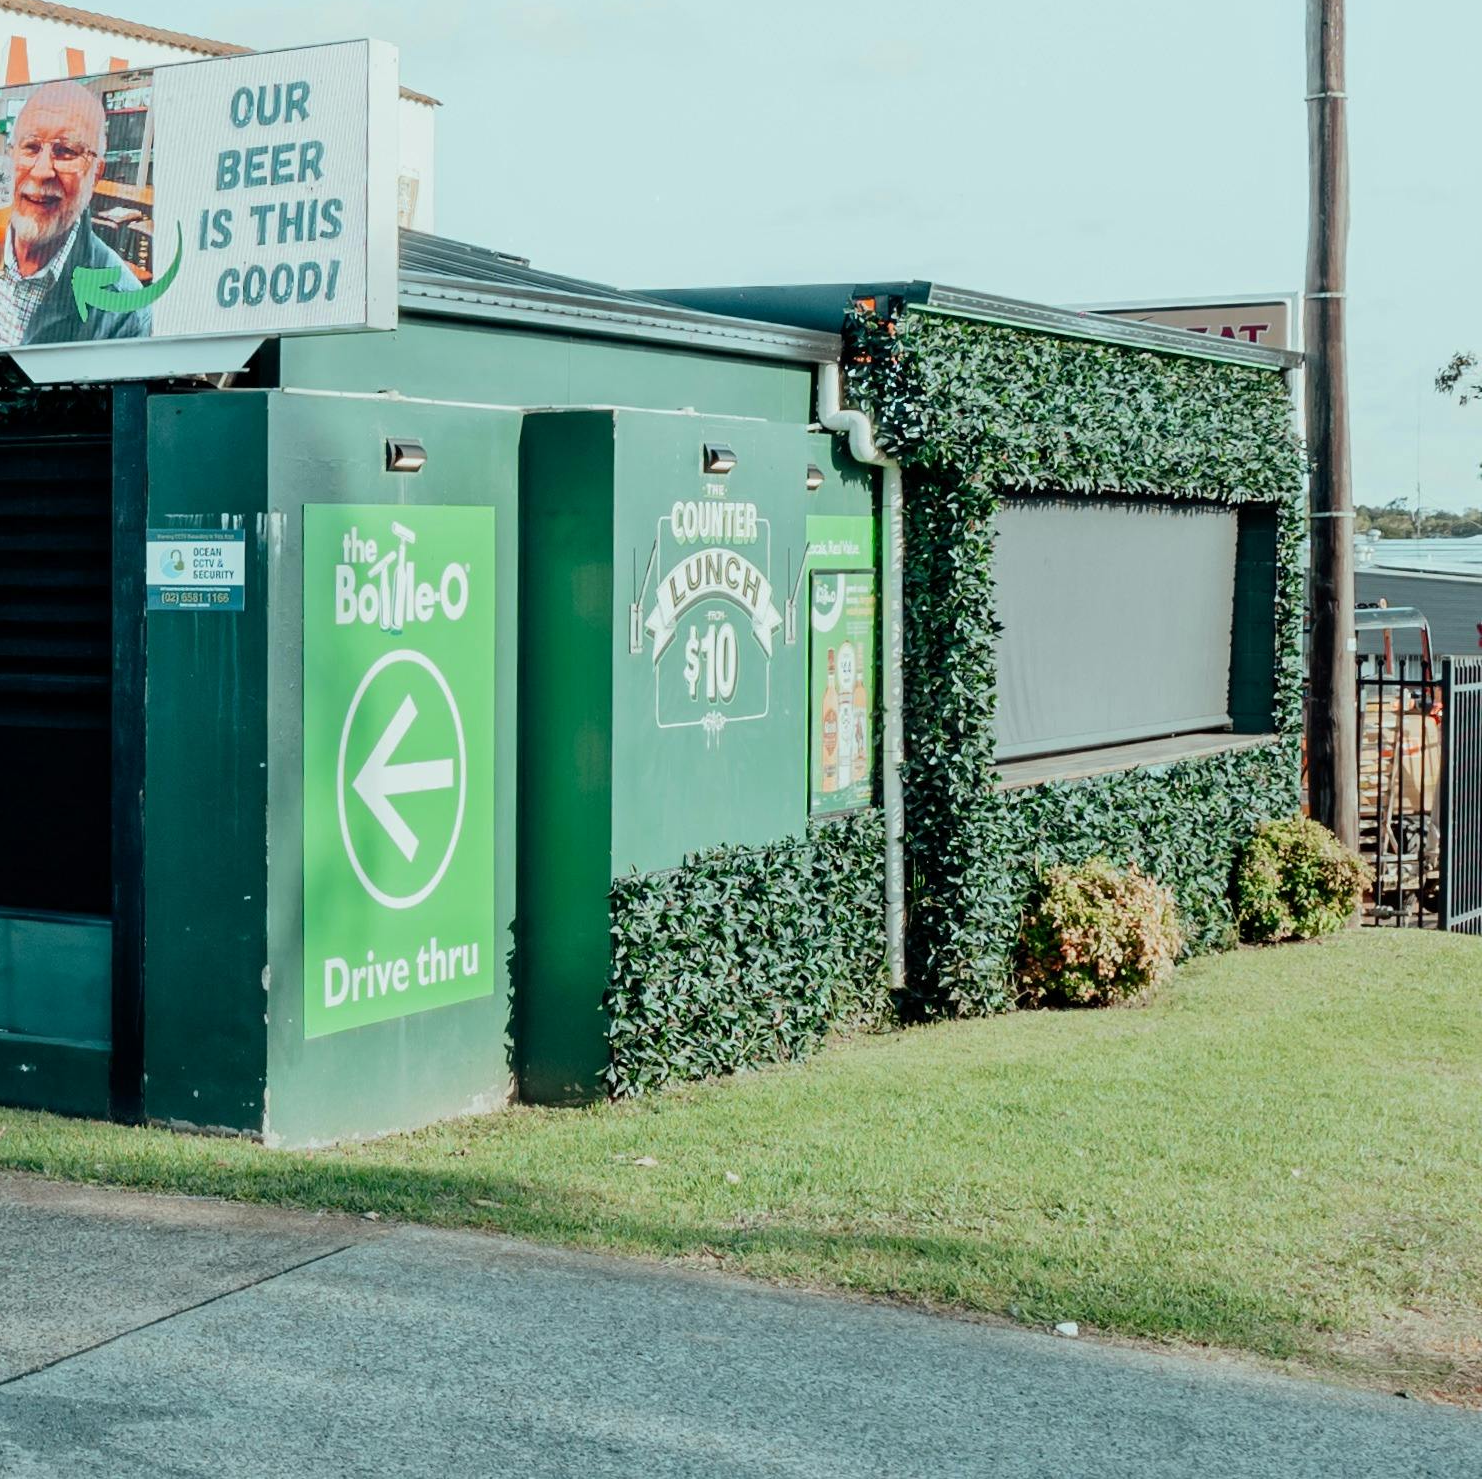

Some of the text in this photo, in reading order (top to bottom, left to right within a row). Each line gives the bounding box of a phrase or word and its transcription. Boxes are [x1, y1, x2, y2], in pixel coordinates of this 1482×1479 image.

[230, 80, 311, 129] OUR
[216, 139, 325, 191] BEER
[198, 198, 344, 251] IS THIS
[216, 259, 342, 309] GOOD!
[705, 483, 726, 496] THE
[342, 526, 378, 564] the
[670, 500, 759, 542] COUNTER
[192, 547, 223, 558] OCEAN
[192, 558, 224, 569] CCTV &
[192, 570, 235, 580] SECURITY
[335, 521, 469, 631] Bottle-O
[668, 551, 762, 609] LUNCH
[683, 622, 738, 703] $10
[324, 936, 479, 1009] Drive thru
